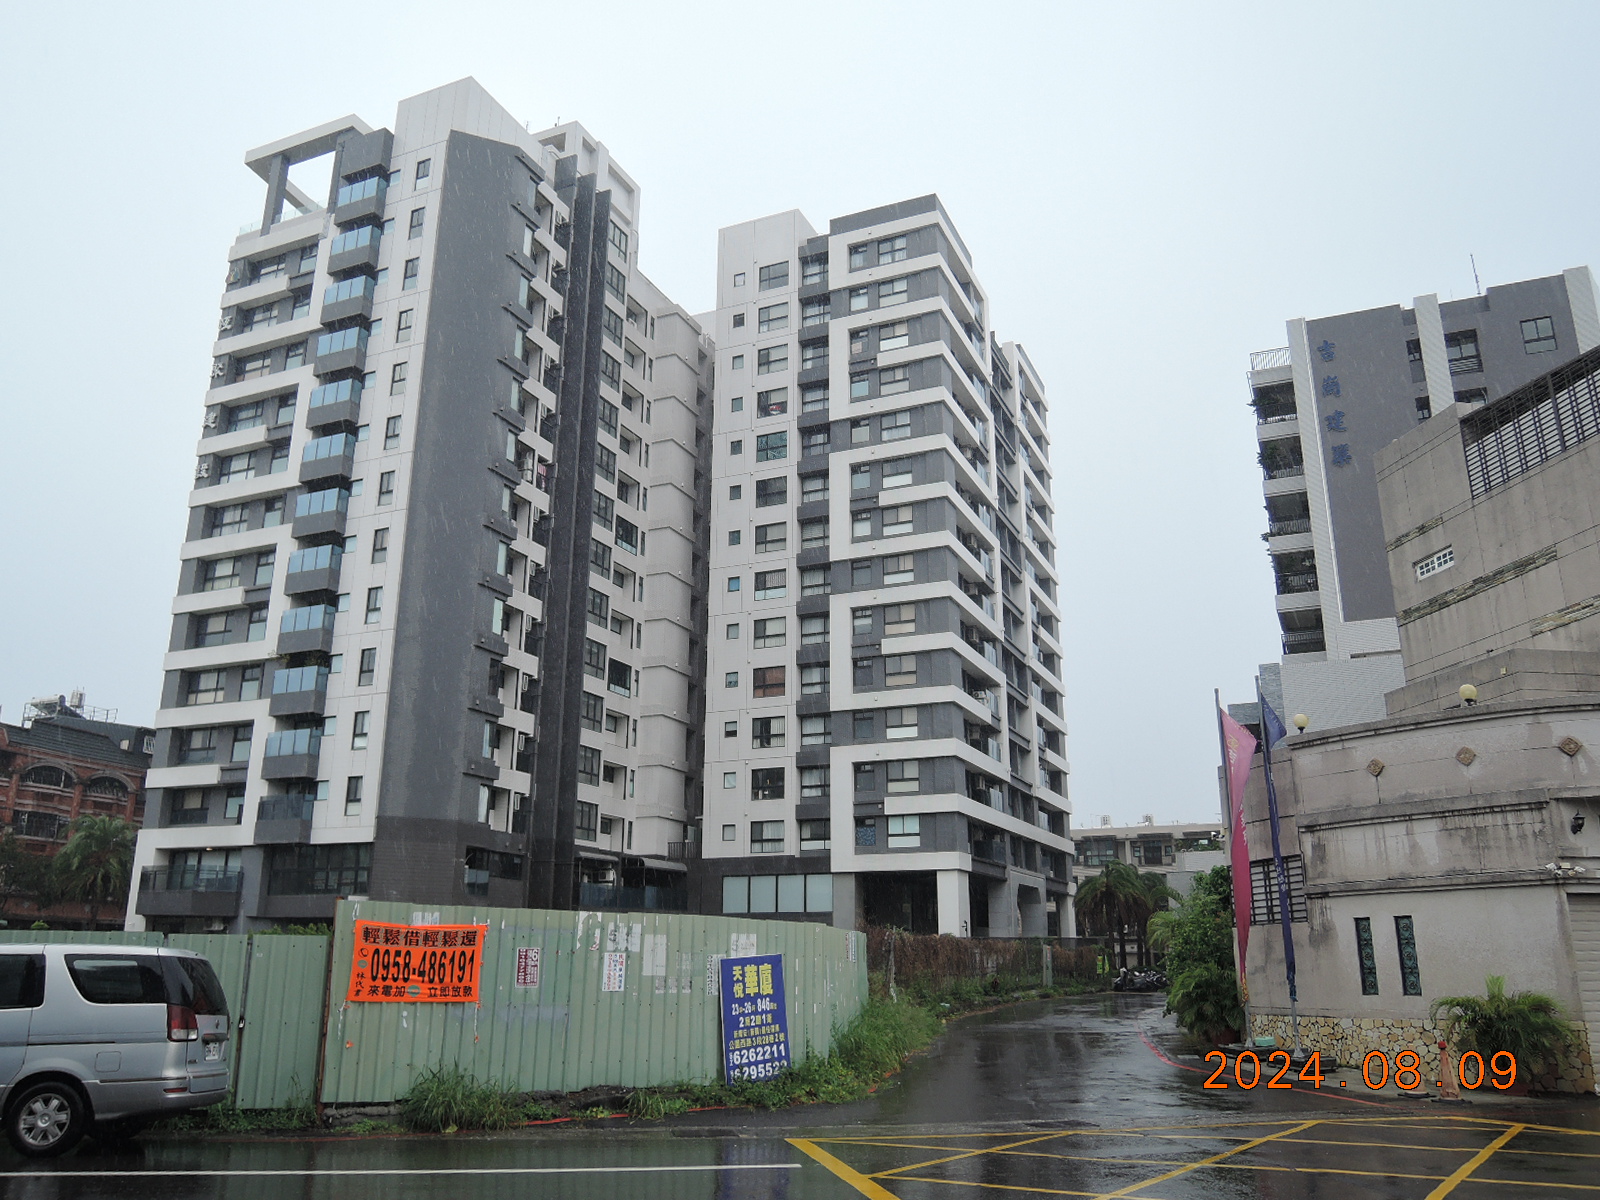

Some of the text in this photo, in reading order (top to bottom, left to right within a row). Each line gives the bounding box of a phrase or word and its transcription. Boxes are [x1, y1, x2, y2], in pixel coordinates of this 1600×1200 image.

[362, 926, 478, 947] 輕鬆借輕鬆還
[370, 948, 475, 984] 0958-486191
[353, 972, 366, 997] 林代書
[367, 985, 406, 998] 來電加
[427, 985, 473, 998] 立即放款
[744, 963, 774, 997] 華廈
[733, 1043, 786, 1066] 6262211
